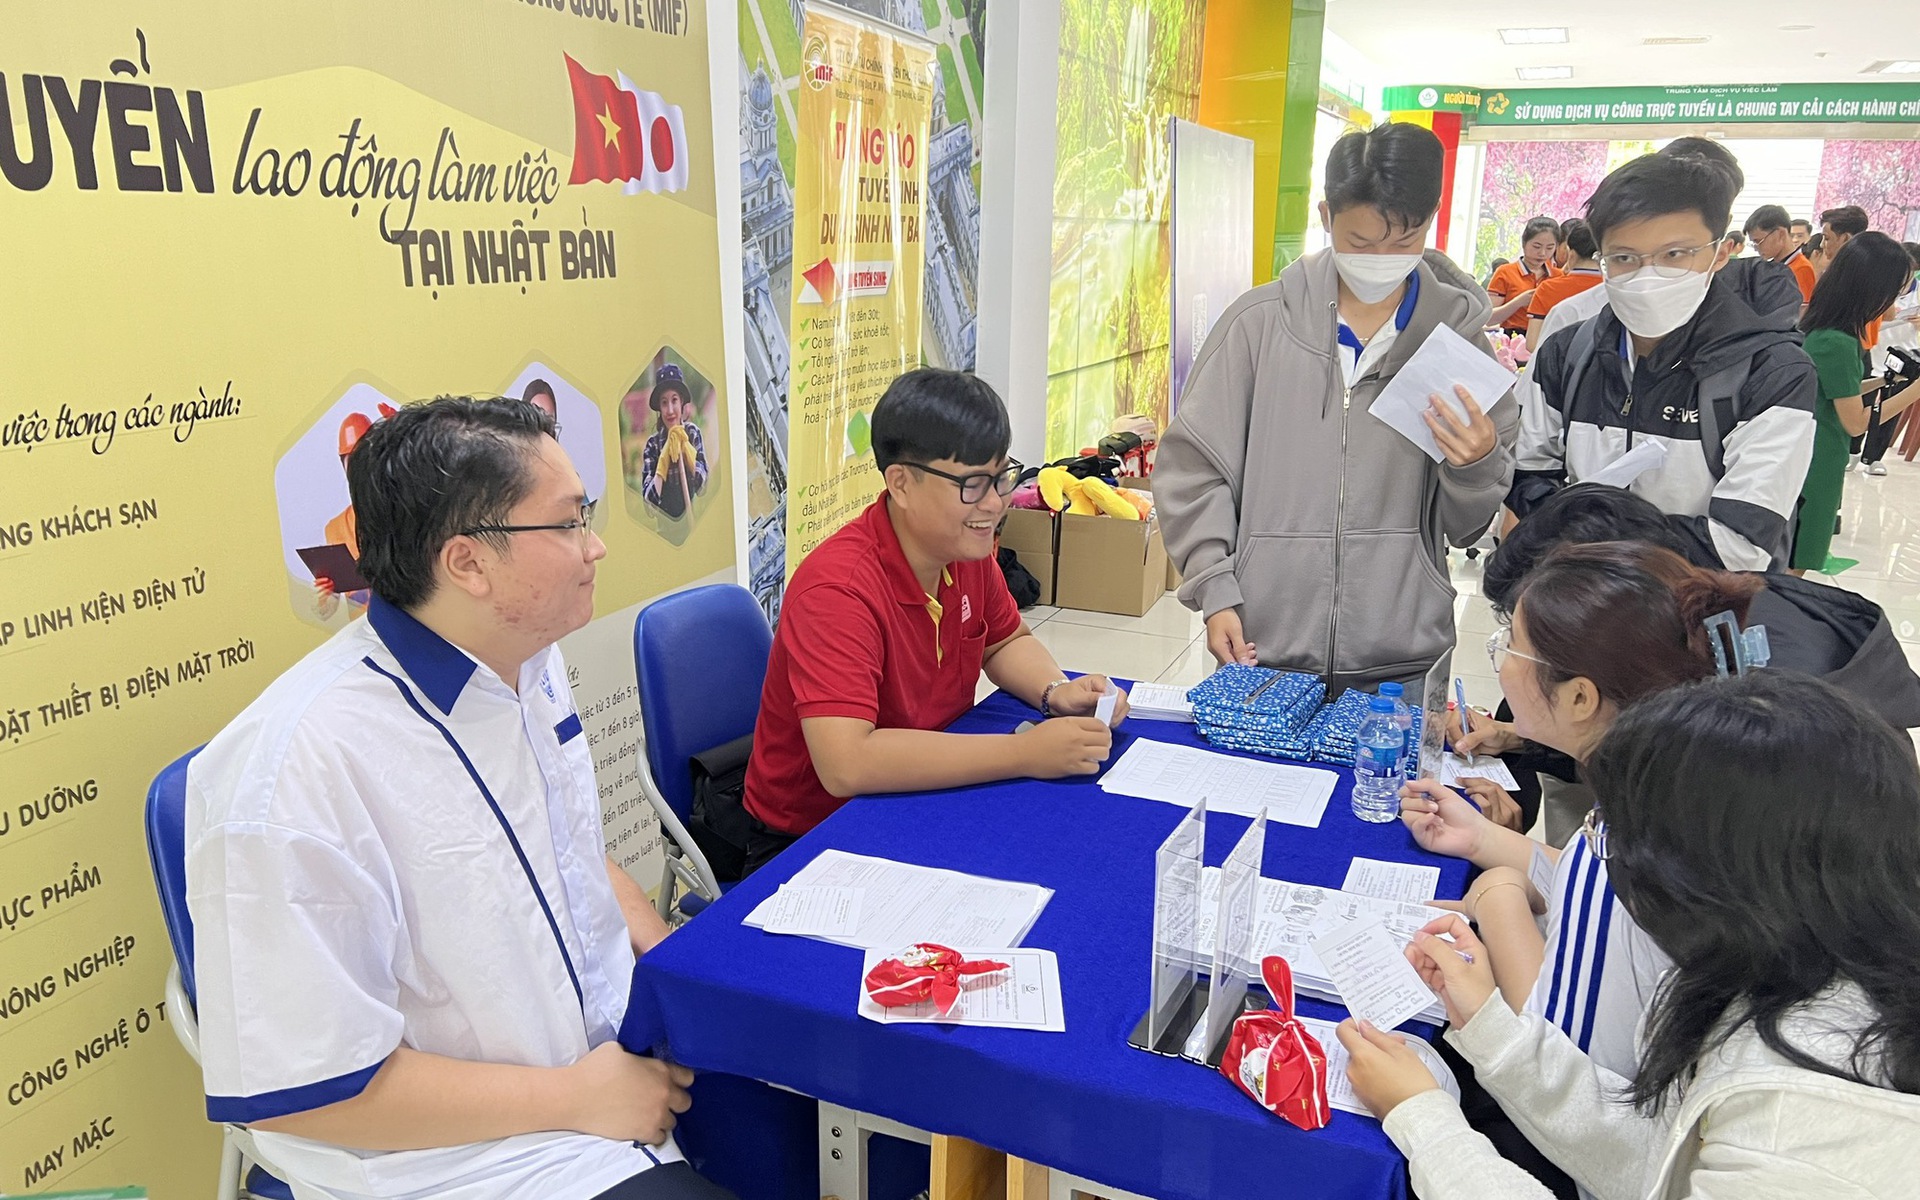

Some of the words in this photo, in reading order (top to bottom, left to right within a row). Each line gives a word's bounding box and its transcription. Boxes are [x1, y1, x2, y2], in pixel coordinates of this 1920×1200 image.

[647, 0, 688, 37] (MIF)
[1515, 101, 1531, 119] SỬ
[1532, 105, 1562, 122] DỤNG
[1565, 104, 1592, 121] DỊCH
[1594, 104, 1609, 121] VỤ
[1611, 101, 1643, 119] CÔNG
[1646, 102, 1675, 120] TRỰC
[1678, 97, 1716, 117] TUYẾN
[1717, 99, 1733, 117] LÀ
[1735, 101, 1776, 117] CHUNG
[1779, 101, 1799, 116] TAY
[1802, 96, 1823, 116] CẢI
[1825, 98, 1859, 117] CÁCH
[1861, 98, 1897, 116] HÀNH
[232, 108, 311, 197] lao
[319, 118, 420, 243] động
[428, 127, 499, 203] làm
[503, 149, 560, 220] việc
[821, 214, 837, 244] DU
[393, 228, 453, 300] TẠI
[467, 219, 550, 295] NHẬT
[561, 207, 617, 281] BẢN
[811, 337, 823, 349] Có
[1, 409, 50, 453] việc
[55, 403, 117, 455] trong
[124, 393, 165, 430] các
[169, 381, 242, 443] ngành:
[804, 393, 823, 408] phát
[41, 505, 112, 540] KHÁCH
[120, 498, 158, 529] SẠN
[24, 607, 73, 640] LINH
[80, 591, 126, 624] KIỆN
[133, 578, 176, 611] ĐIỆN
[181, 567, 206, 594] TỬ
[38, 682, 92, 728] THIẾT
[100, 683, 119, 709] BỊ
[126, 667, 170, 699] ĐIỆN
[177, 654, 213, 683] MẶT
[217, 637, 255, 671] TRỜI
[605, 697, 610, 709] 3
[612, 687, 625, 705] đến
[627, 686, 632, 698] 5
[601, 728, 605, 739] 7
[607, 718, 621, 737] đến
[622, 717, 628, 728] 8
[600, 752, 617, 769] triệu
[614, 772, 623, 790] về
[19, 778, 99, 828] DƯỠNG
[603, 807, 616, 826] đến
[617, 801, 629, 815] 120
[619, 828, 632, 844] tiện
[624, 851, 640, 868] theo
[641, 838, 654, 857] luật
[41, 861, 102, 914] PHẨM
[63, 935, 136, 985] NGHIỆP
[7, 1058, 68, 1106] CÔNG
[75, 1018, 129, 1069] NGHỆ
[135, 1007, 150, 1033] Ô
[25, 1144, 65, 1188] MAY
[72, 1116, 115, 1158] MẶC
